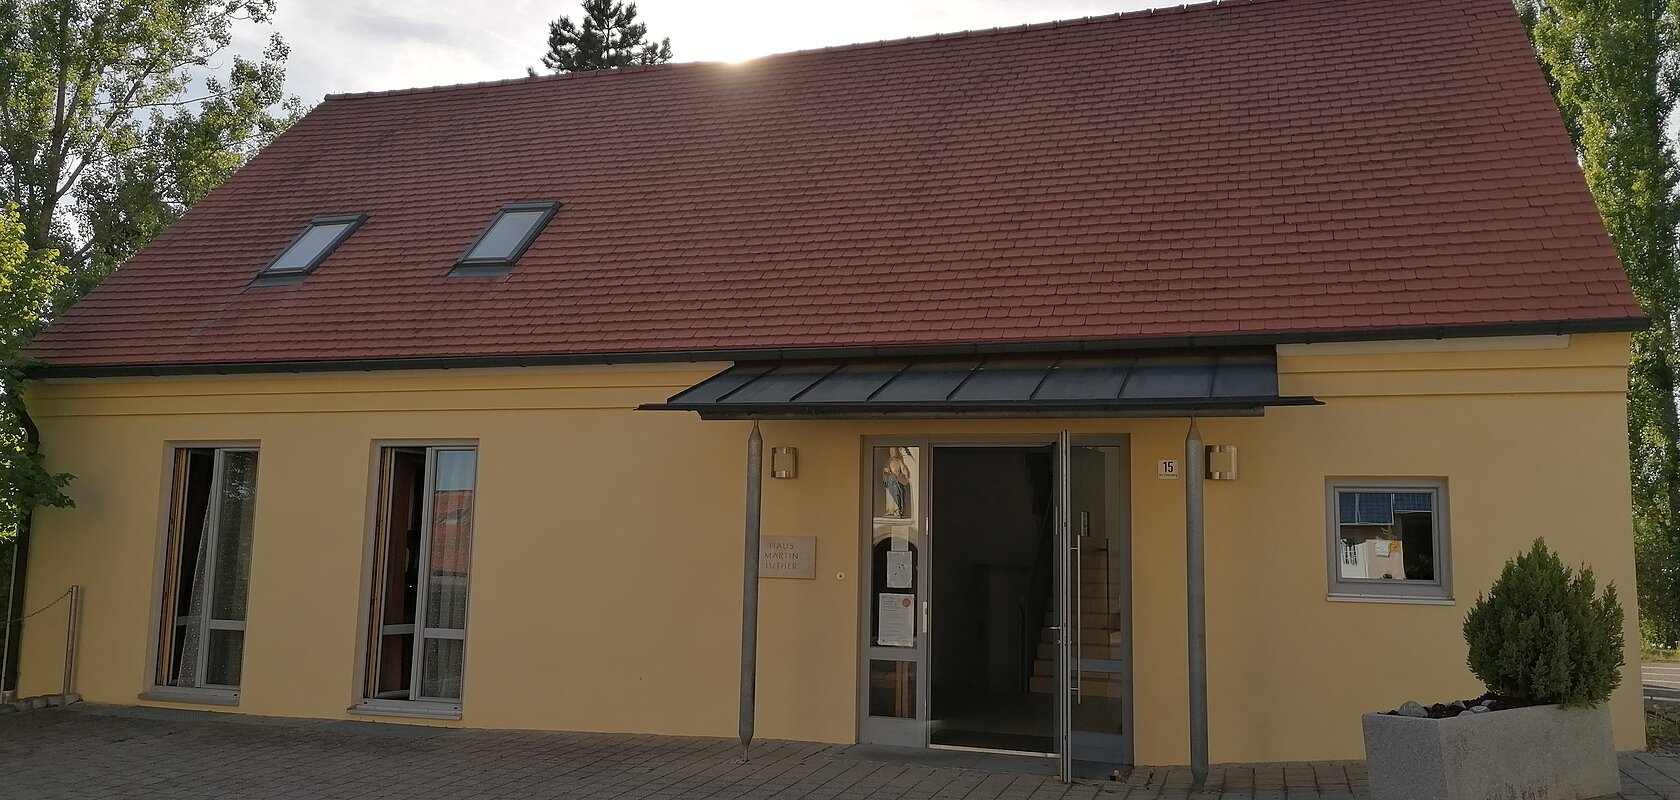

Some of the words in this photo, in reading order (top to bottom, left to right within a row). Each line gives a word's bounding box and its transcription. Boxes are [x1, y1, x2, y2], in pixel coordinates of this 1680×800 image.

[1162, 461, 1174, 473] 15
[769, 542, 794, 550] HAUS
[764, 552, 799, 560] MARTIN
[765, 562, 797, 570] LUTHER
